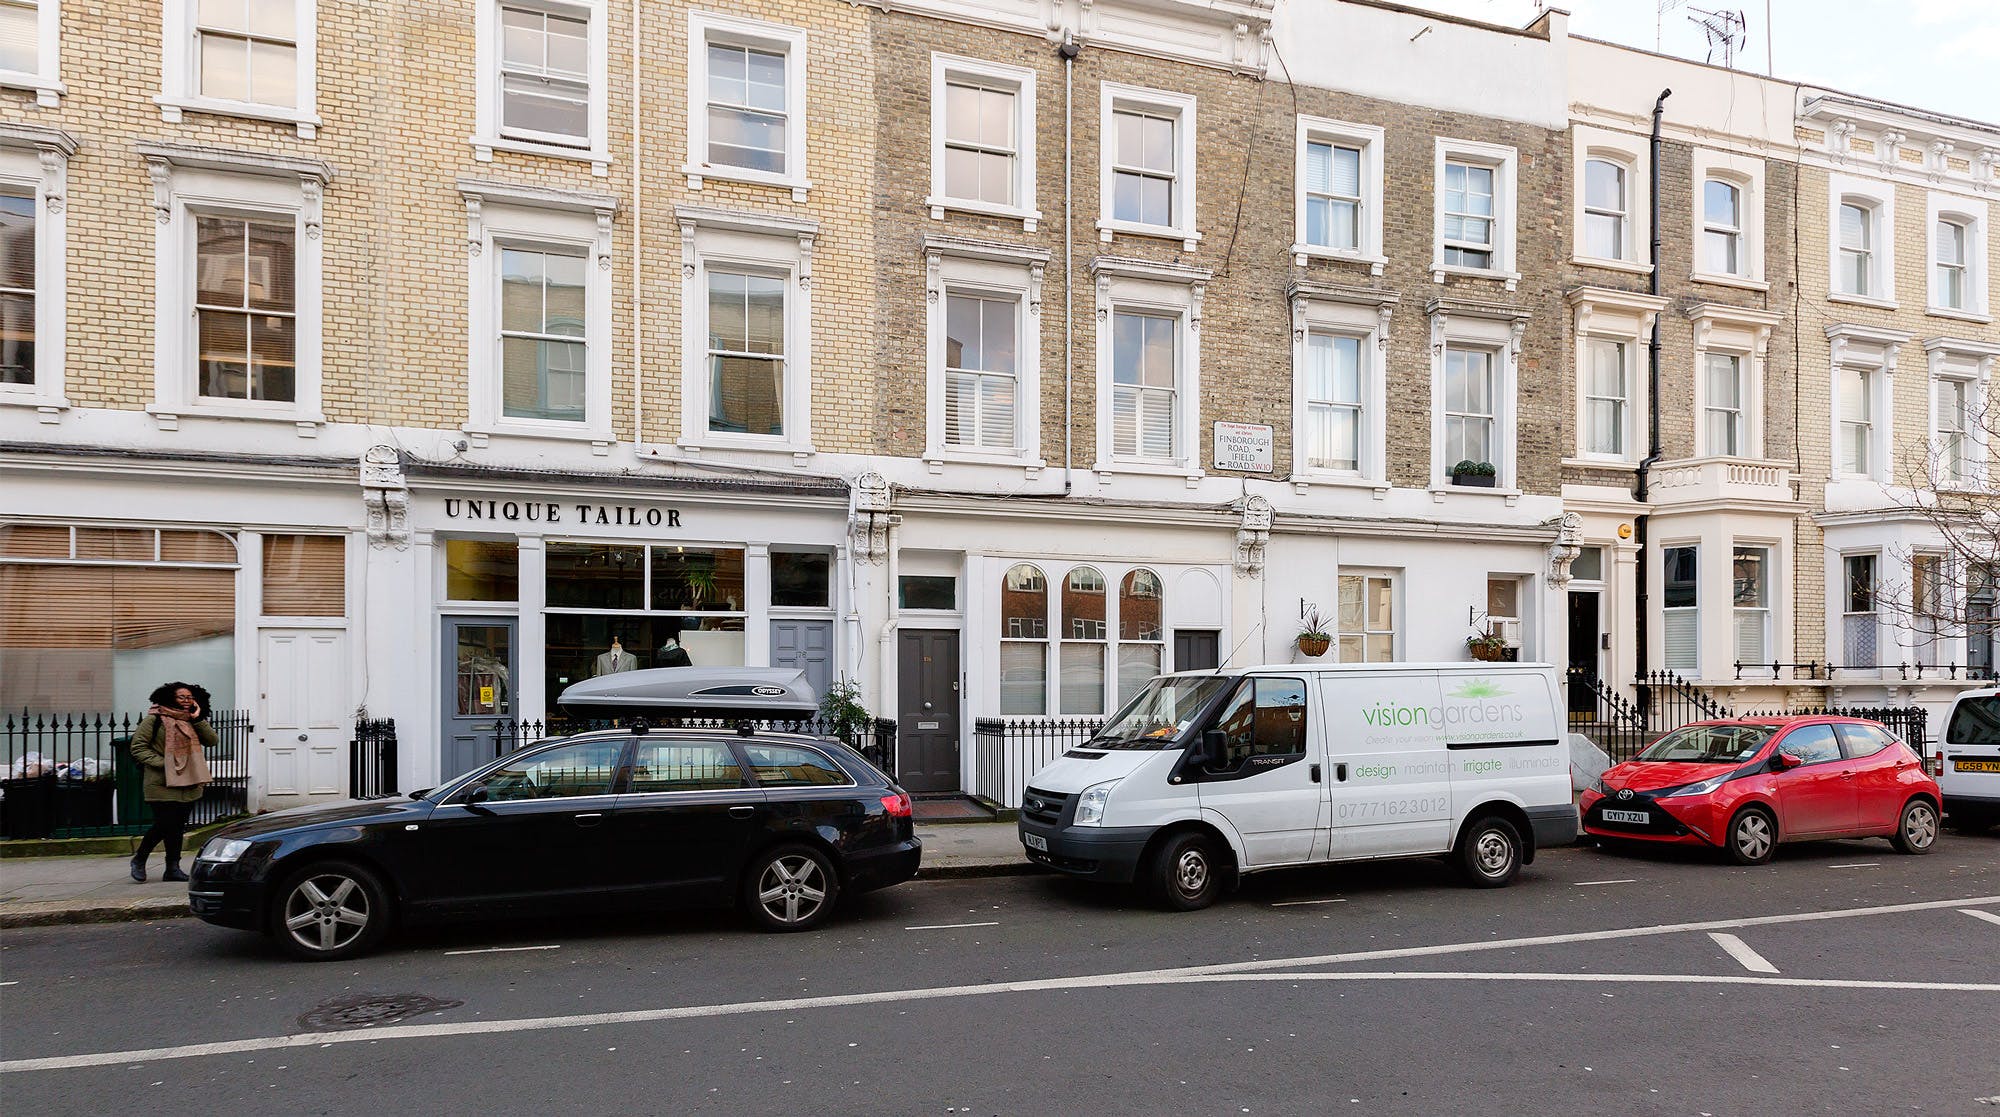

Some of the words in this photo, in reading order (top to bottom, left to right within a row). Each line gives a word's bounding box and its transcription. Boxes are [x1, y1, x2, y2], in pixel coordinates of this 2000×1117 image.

[1219, 435, 1269, 446] FINBOROUGH
[1232, 453, 1255, 462] IFIELD
[444, 499, 560, 521] UNIQUE
[576, 505, 682, 527] TAILOR
[1362, 700, 1523, 729] visiongardens
[1435, 730, 1523, 742] www.visiongardens.co.uk
[1356, 763, 1397, 779] design
[1404, 759, 1456, 775] maintain
[1463, 759, 1502, 774] irrigate
[1509, 756, 1560, 770] illuminate
[1956, 762, 1982, 771] LG58
[1339, 797, 1447, 819] 07771623012
[1607, 811, 1625, 821] GY17
[1627, 812, 1644, 822] XZU
